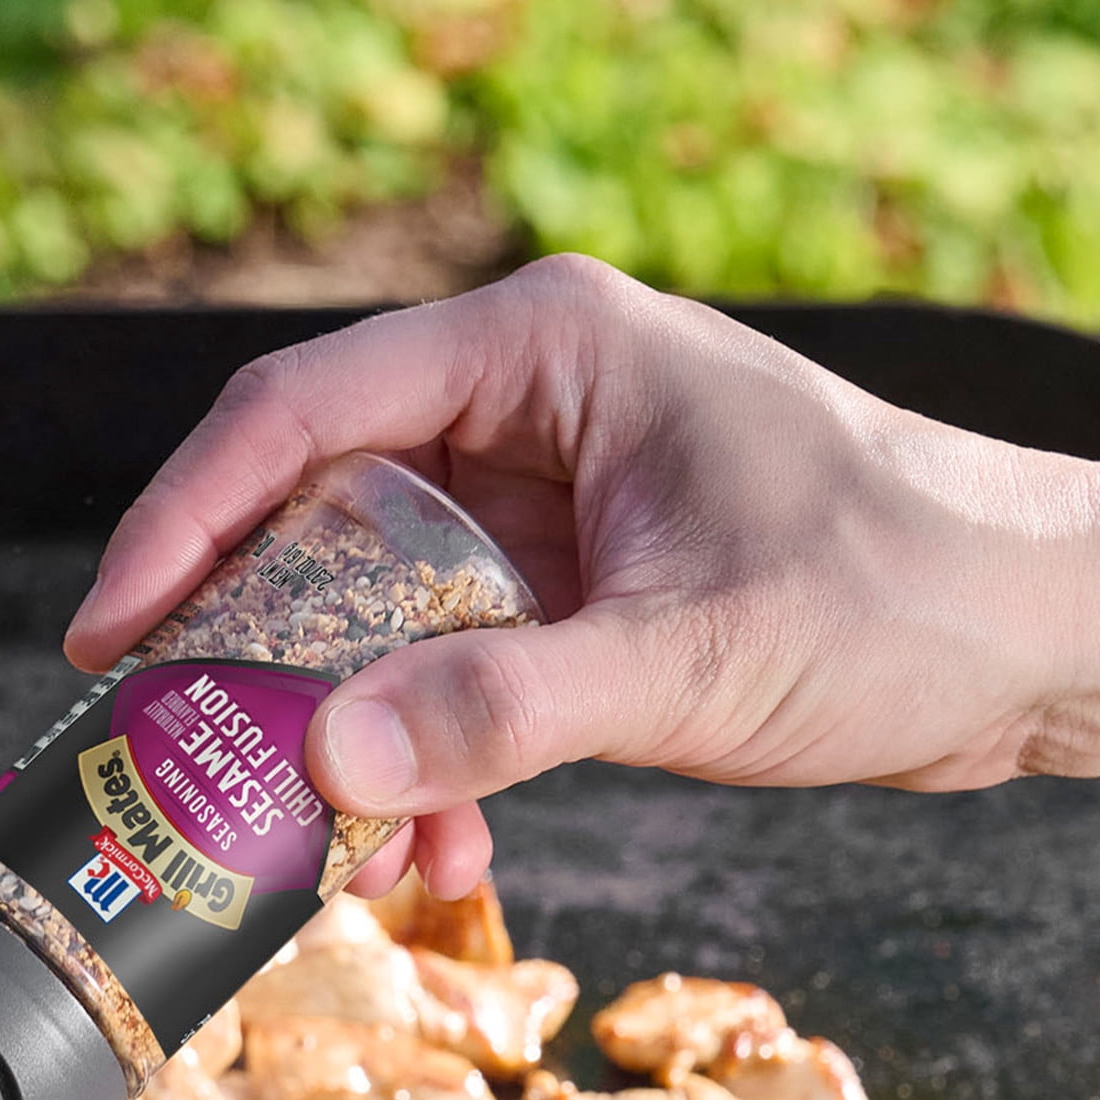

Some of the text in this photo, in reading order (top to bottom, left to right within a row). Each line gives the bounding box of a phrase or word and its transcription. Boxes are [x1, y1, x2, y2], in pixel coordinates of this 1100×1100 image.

[270, 567, 293, 589] NET
[294, 555, 316, 577] OZ
[304, 563, 334, 591] 2.37
[143, 700, 187, 739] NATURALLY
[161, 690, 200, 727] FLAVORED
[184, 674, 323, 827] CHILI FUSION
[178, 721, 284, 836] SESAME
[155, 758, 237, 850] SEASONING
[101, 836, 158, 898] McCormick
[160, 849, 235, 913] Grill
